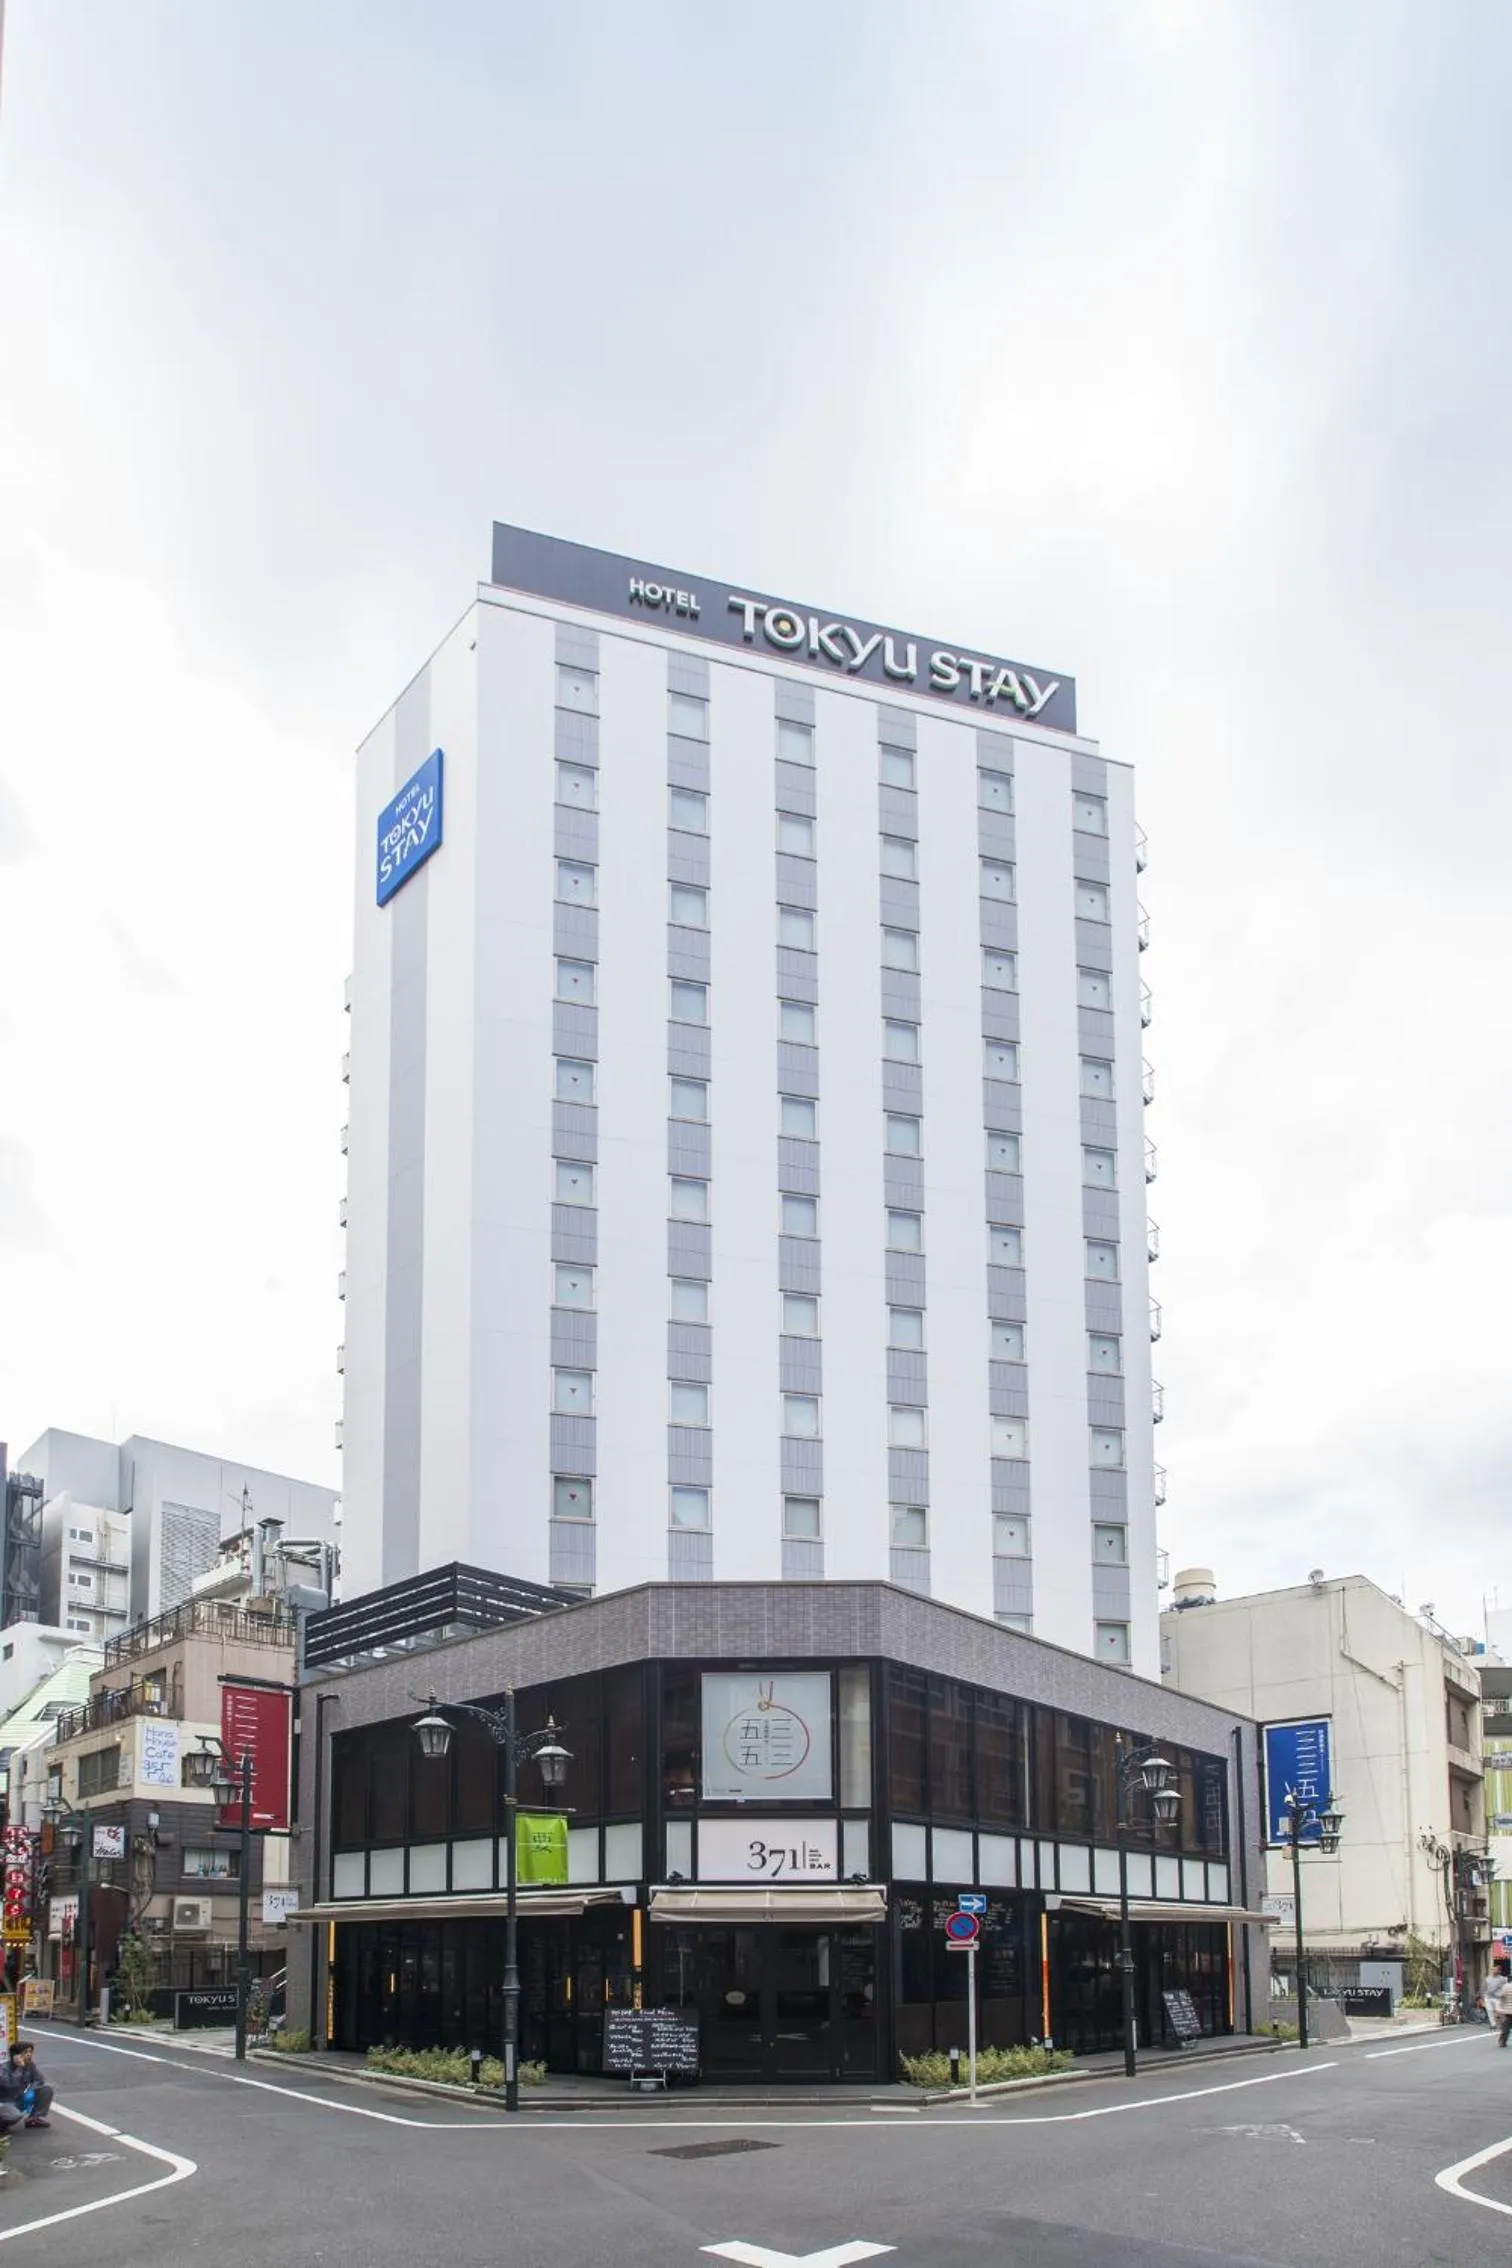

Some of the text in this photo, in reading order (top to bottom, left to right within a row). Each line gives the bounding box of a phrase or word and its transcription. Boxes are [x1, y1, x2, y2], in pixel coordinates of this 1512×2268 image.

[630, 577, 701, 612] HOTEL
[729, 596, 1059, 717] TOKYU STAY
[395, 783, 420, 817] HOTEL
[380, 786, 434, 853] TOKYU
[380, 806, 433, 882] STAY
[747, 1841, 800, 1877] 371
[188, 1995, 226, 2004] TOKYU
